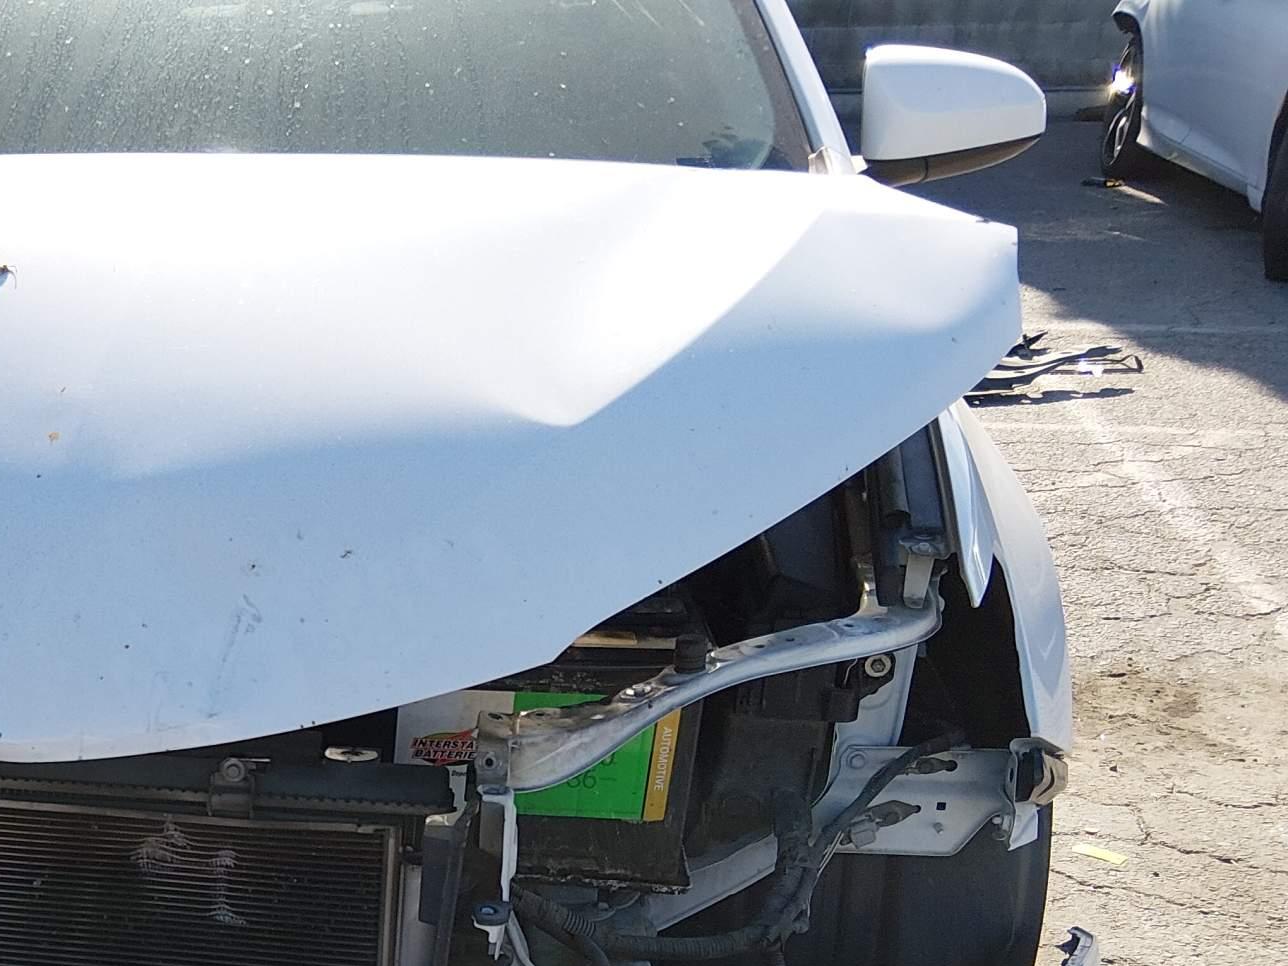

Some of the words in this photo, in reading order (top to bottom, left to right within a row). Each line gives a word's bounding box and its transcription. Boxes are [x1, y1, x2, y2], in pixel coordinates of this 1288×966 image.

[412, 737, 475, 750] INTERSTA
[413, 749, 477, 760] BATTERIE
[654, 727, 673, 791] AUTOMOTIVE
